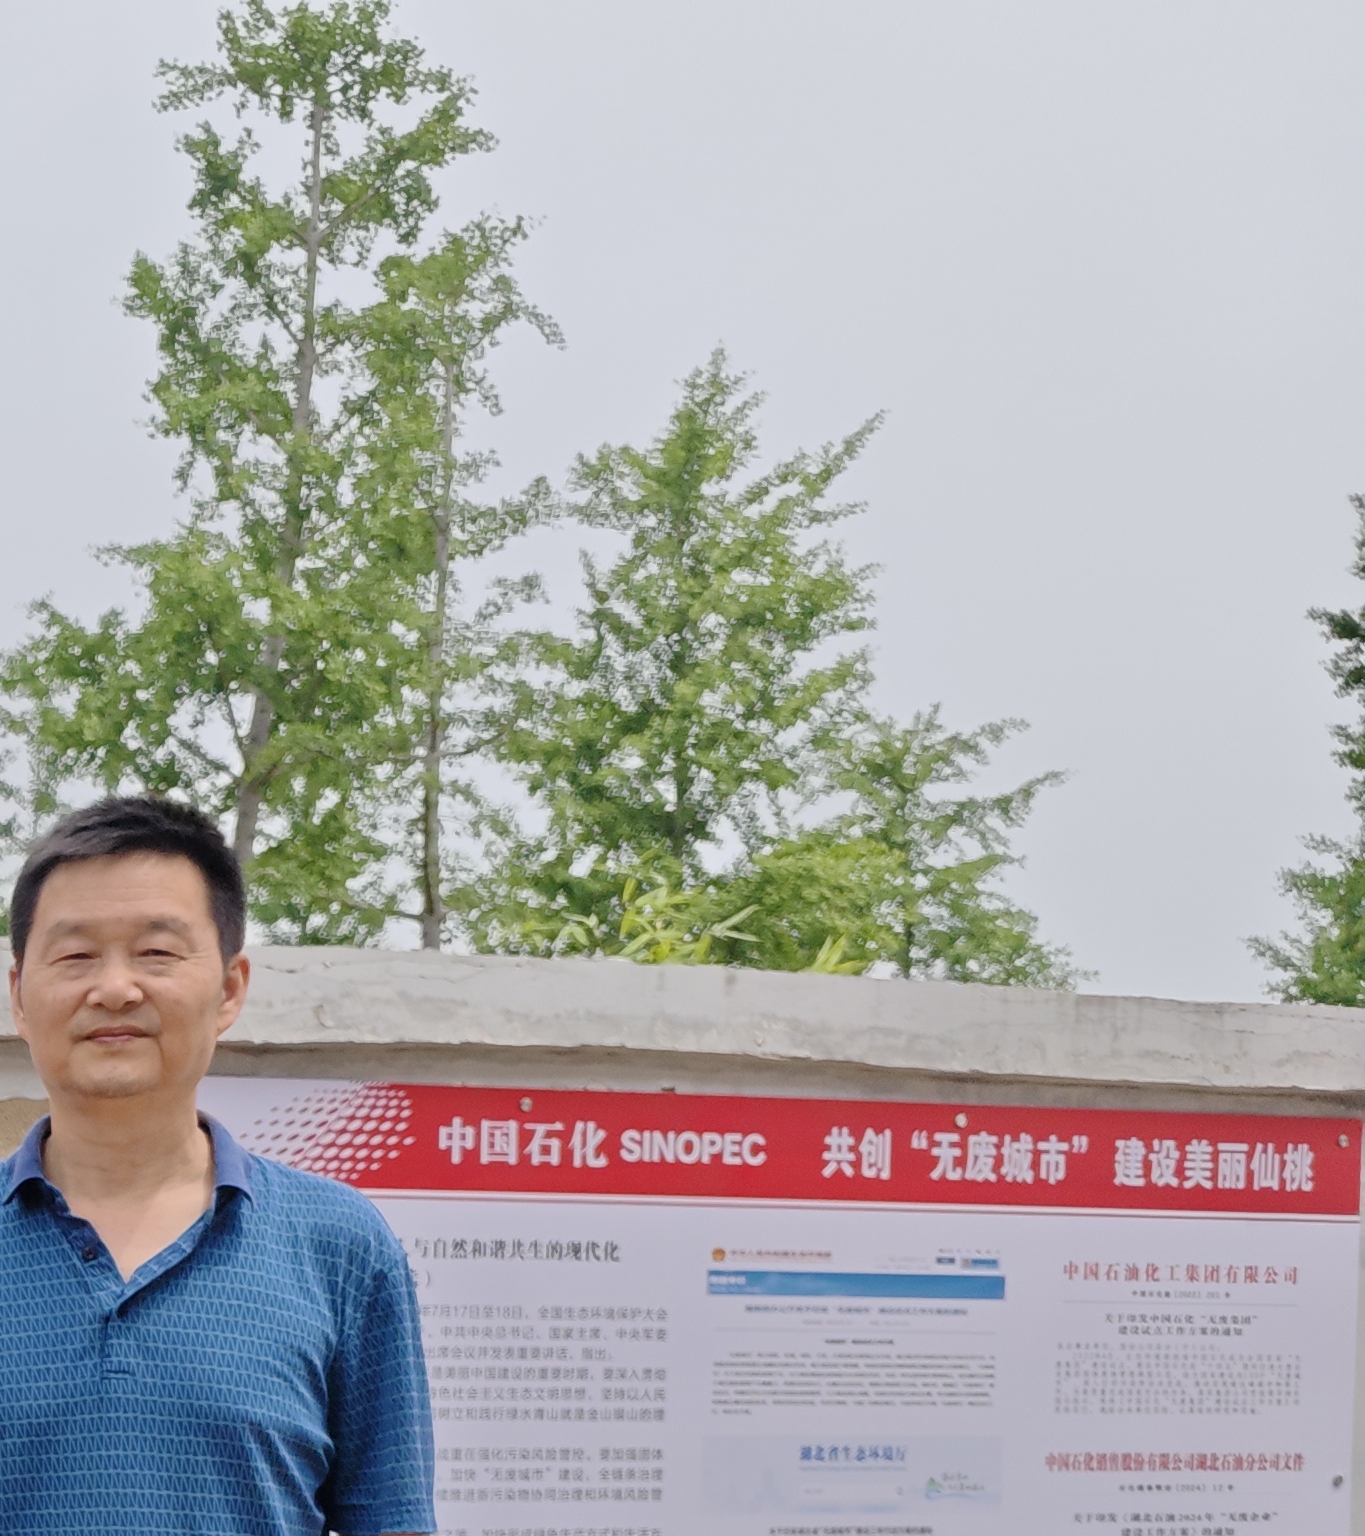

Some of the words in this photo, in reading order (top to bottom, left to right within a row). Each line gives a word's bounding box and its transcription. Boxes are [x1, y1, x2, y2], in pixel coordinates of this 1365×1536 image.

[437, 1116, 608, 1169] 中国石化
[619, 1128, 768, 1168] SINOPEC
[1113, 1137, 1317, 1193] 建设美丽仙桃
[1063, 1260, 1299, 1285] 中国石油化工集团有限公司
